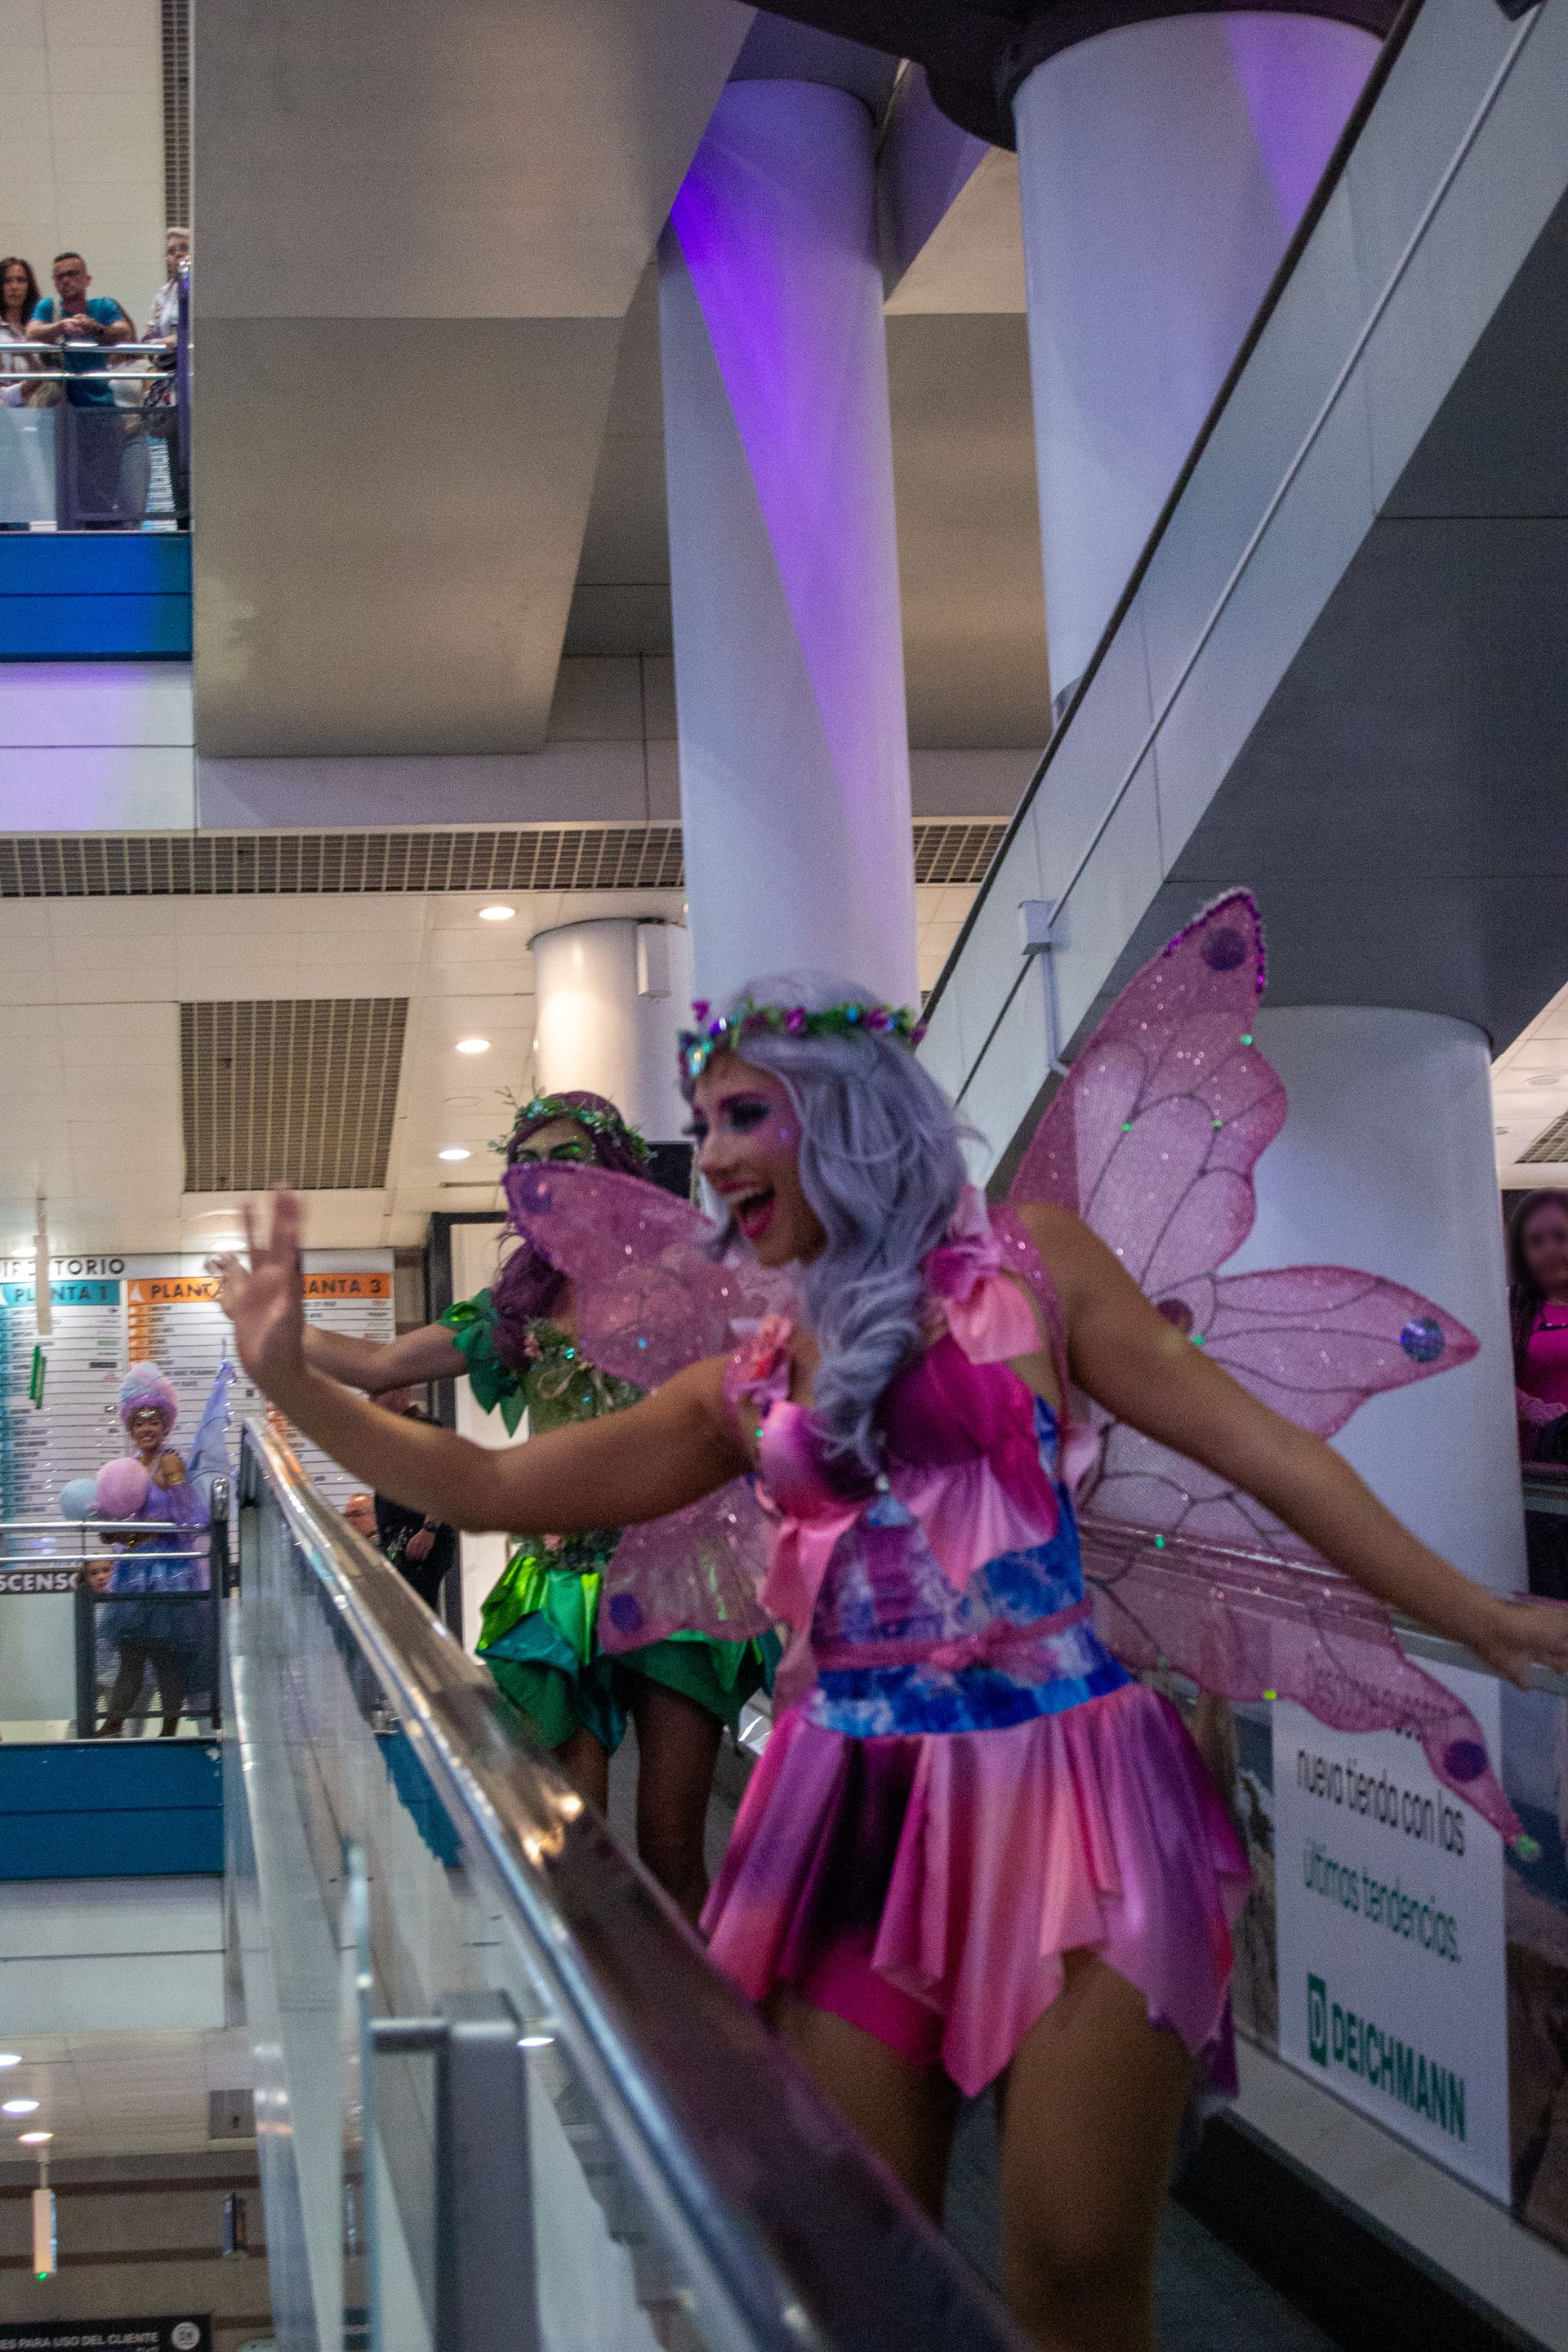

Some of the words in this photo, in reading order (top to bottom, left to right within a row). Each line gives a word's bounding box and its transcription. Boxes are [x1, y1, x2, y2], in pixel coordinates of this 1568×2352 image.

[15, 1286, 90, 1302] PLNTA
[100, 1286, 107, 1299] 1
[303, 1279, 361, 1294] ANTA
[370, 1279, 381, 1293] 3
[1298, 1749, 1343, 1805] nueva
[1402, 1791, 1434, 1844] con
[1437, 1788, 1465, 1856] las
[1332, 2002, 1466, 2141] DEICHMANN
[18, 2337, 51, 2349] PARA
[82, 2334, 105, 2346] DEL
[107, 2332, 159, 2345] CLIENTE
